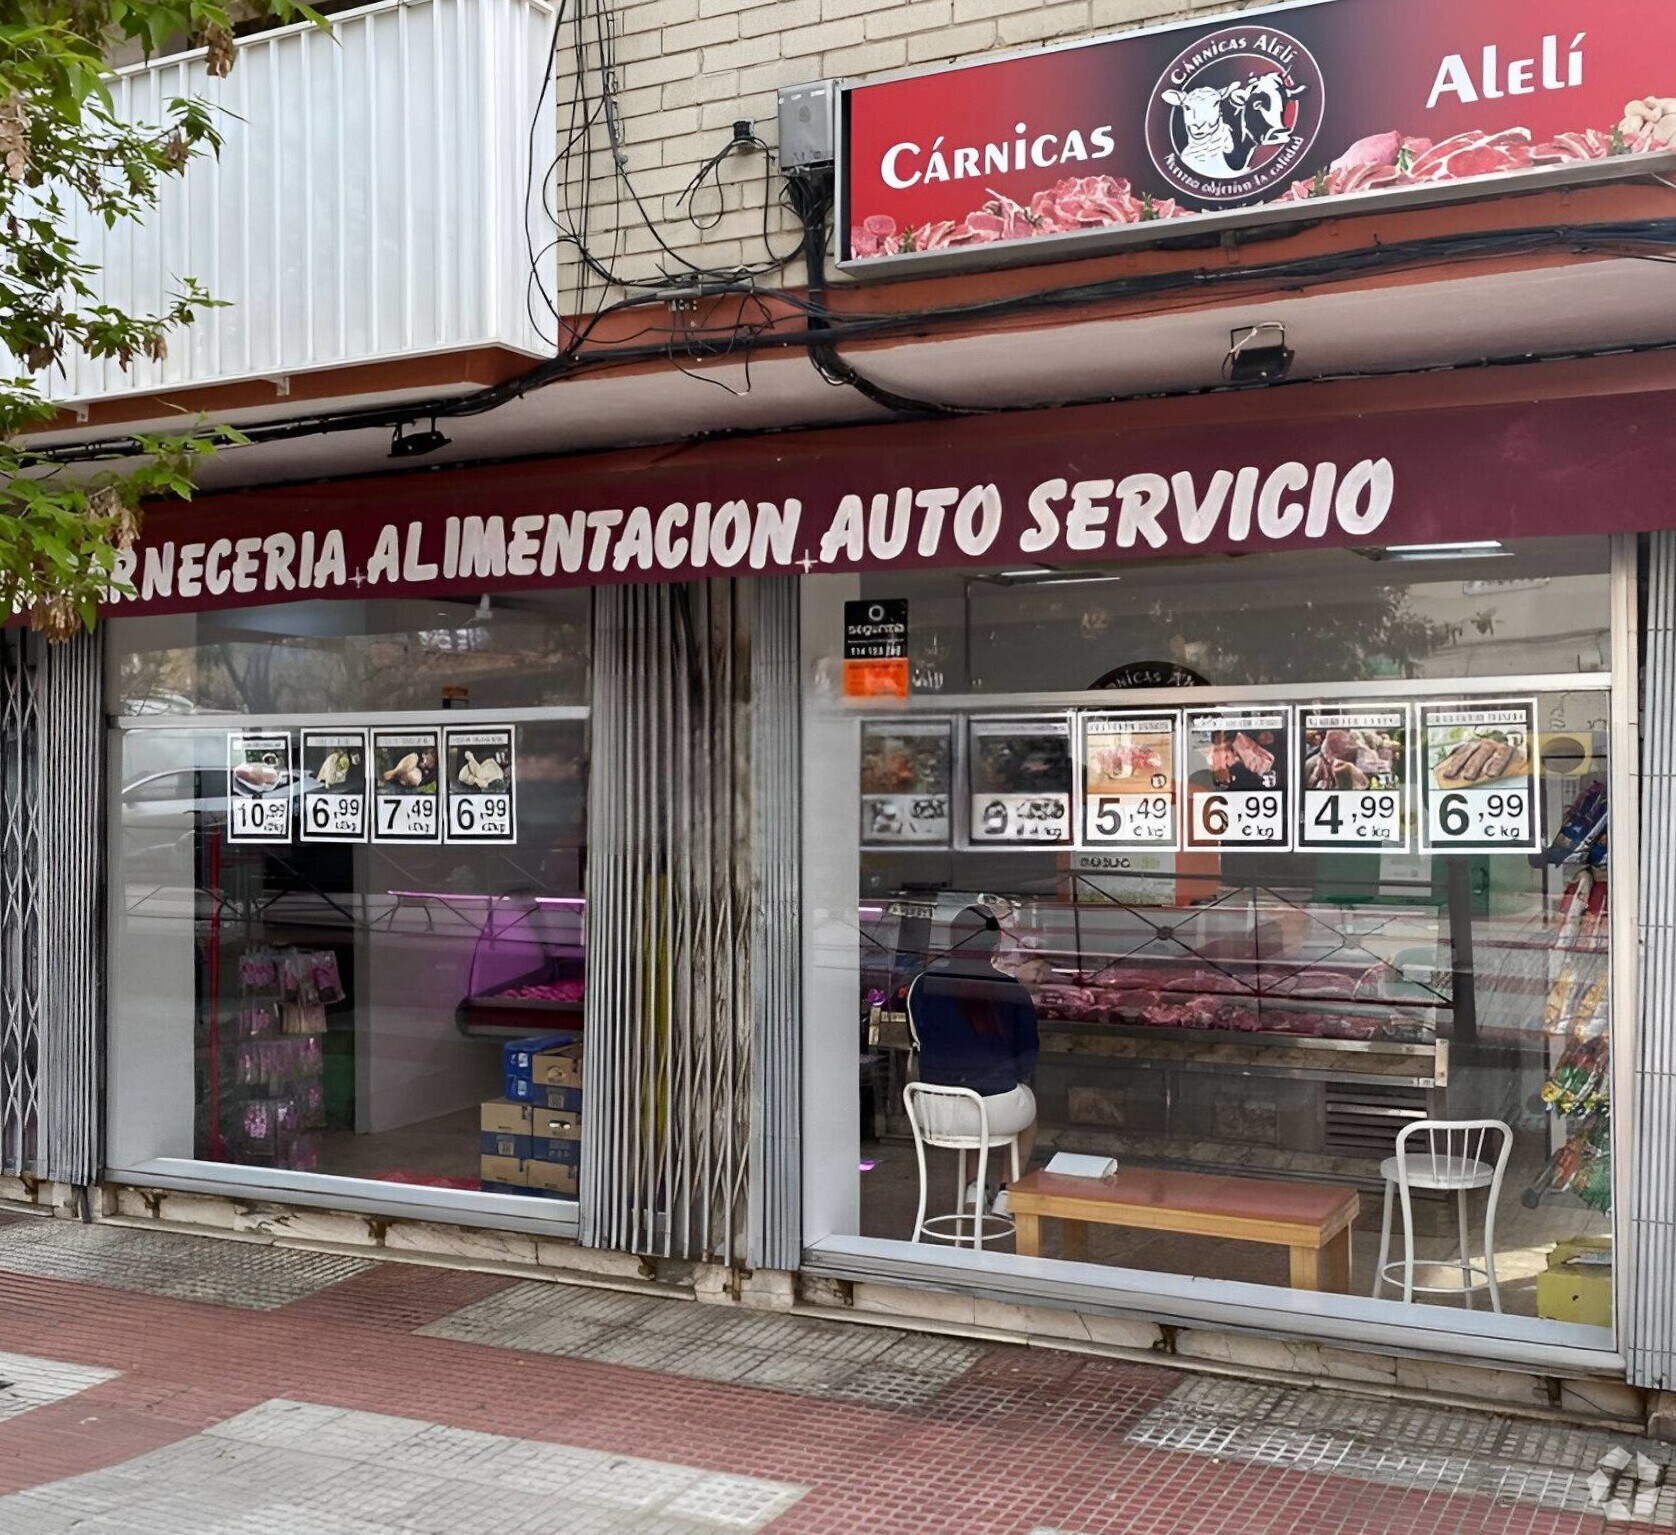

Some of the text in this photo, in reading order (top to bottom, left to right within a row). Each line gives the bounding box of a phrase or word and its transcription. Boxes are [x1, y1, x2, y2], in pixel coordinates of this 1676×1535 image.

[62, 529, 348, 606] RNECERIA
[367, 498, 802, 583] ALIMENTACION
[819, 484, 1001, 563] AUTO
[1018, 457, 1395, 553] SERVICIO
[312, 798, 360, 829] 6,99
[383, 799, 433, 831] 7,49
[456, 798, 507, 831] 6,99
[1095, 797, 1168, 836] 5,49
[1202, 795, 1279, 836] 6,99
[1314, 795, 1395, 835] 4,99
[1438, 793, 1524, 836] 6,99
